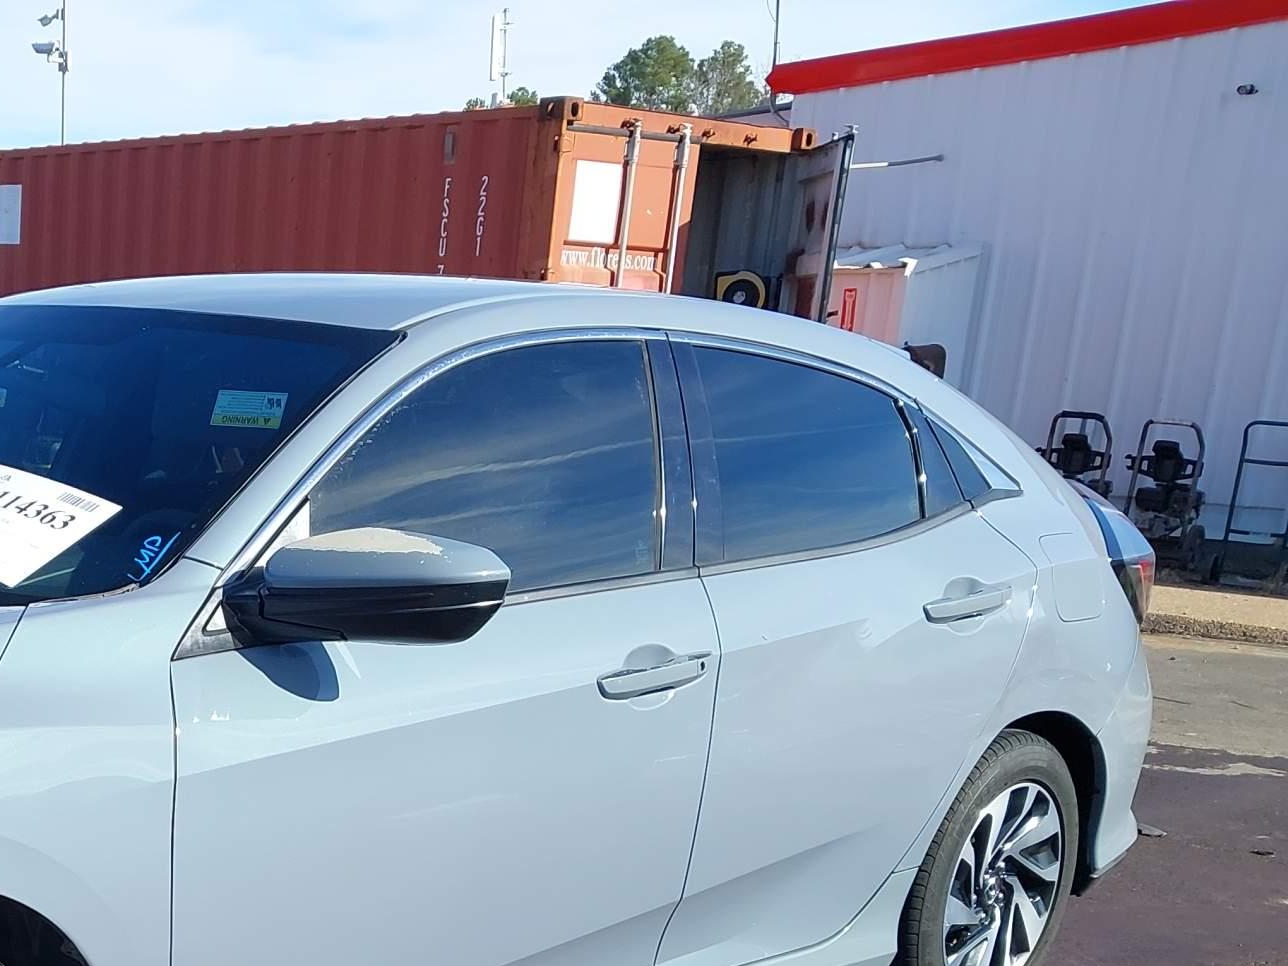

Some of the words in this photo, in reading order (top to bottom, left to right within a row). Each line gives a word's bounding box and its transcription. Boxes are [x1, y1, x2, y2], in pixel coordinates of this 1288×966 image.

[438, 177, 452, 257] FSCU
[475, 175, 489, 257] 22G1
[221, 415, 259, 425] WARNING
